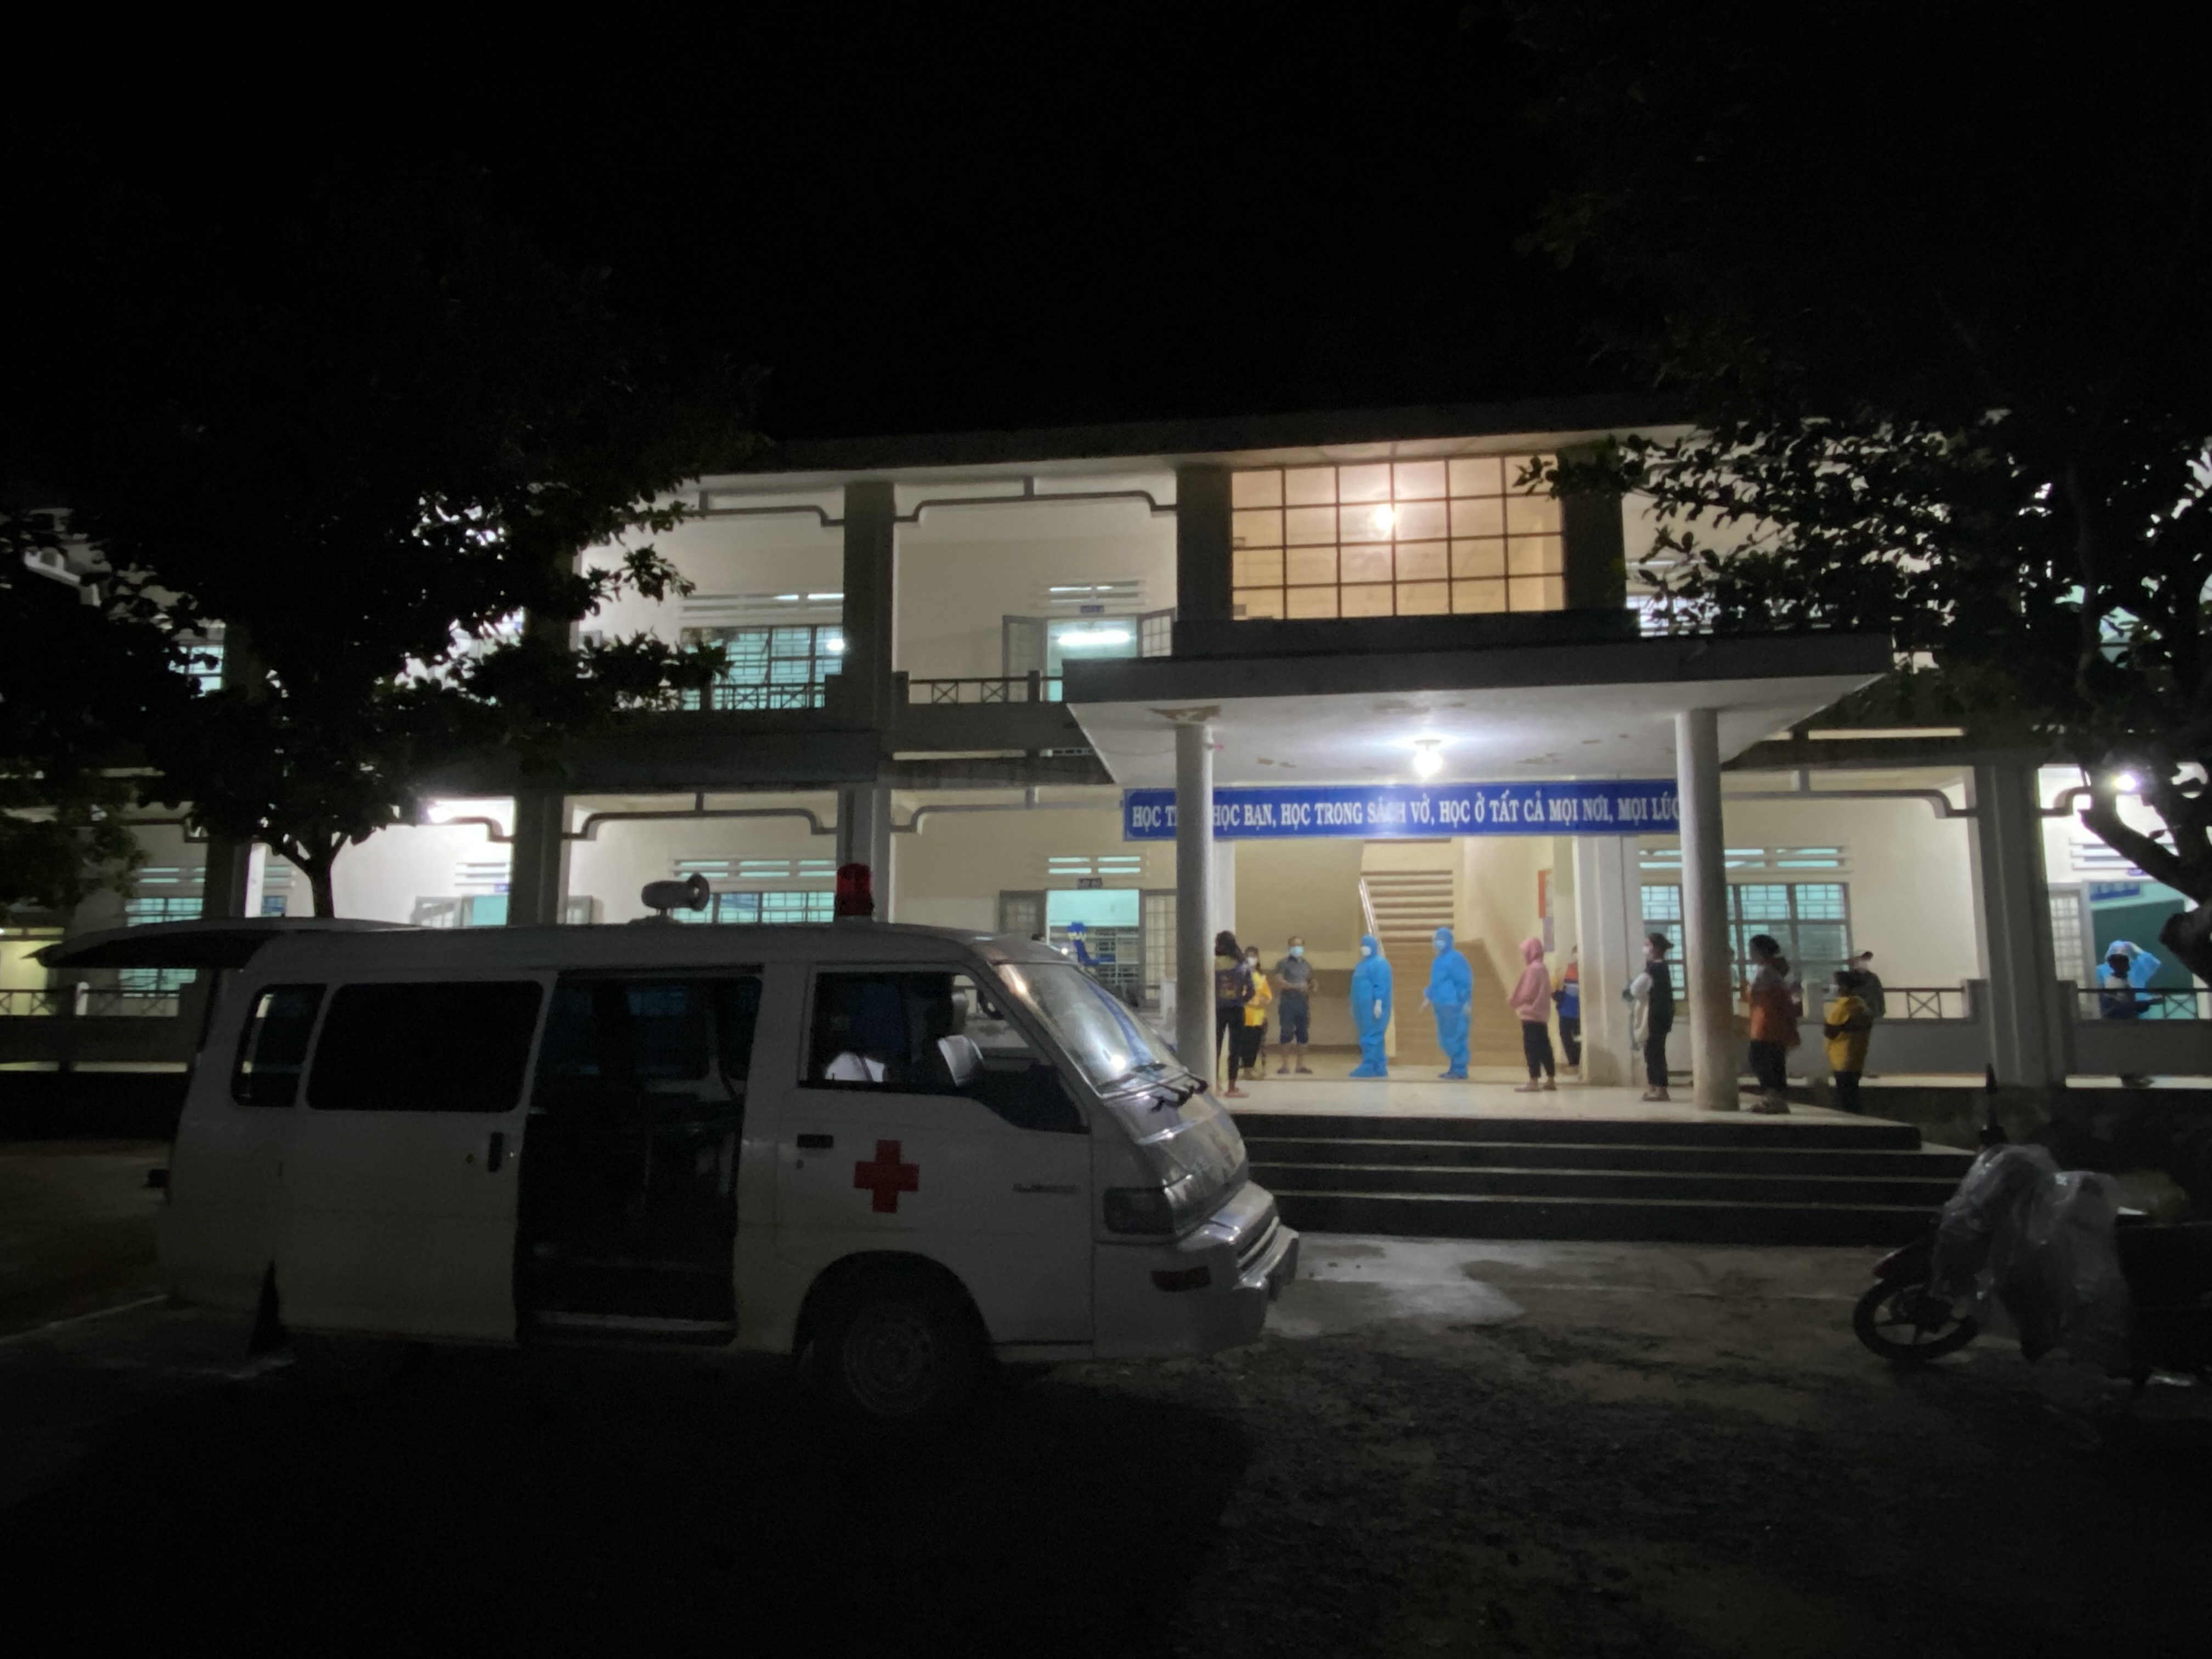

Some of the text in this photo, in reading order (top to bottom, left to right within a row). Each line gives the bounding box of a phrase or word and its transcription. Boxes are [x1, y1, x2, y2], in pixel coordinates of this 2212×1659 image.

[1132, 805, 1161, 832] HỌC
[1244, 803, 1277, 831] BẠN,
[1281, 802, 1311, 831] HỌC
[1314, 802, 1363, 825] TRONG
[1439, 799, 1470, 828] HỌC
[1489, 789, 1519, 822] TẤT
[1523, 791, 1545, 822] CẢ
[1549, 798, 1578, 826] MỌI
[1617, 797, 1647, 826] MỌI
